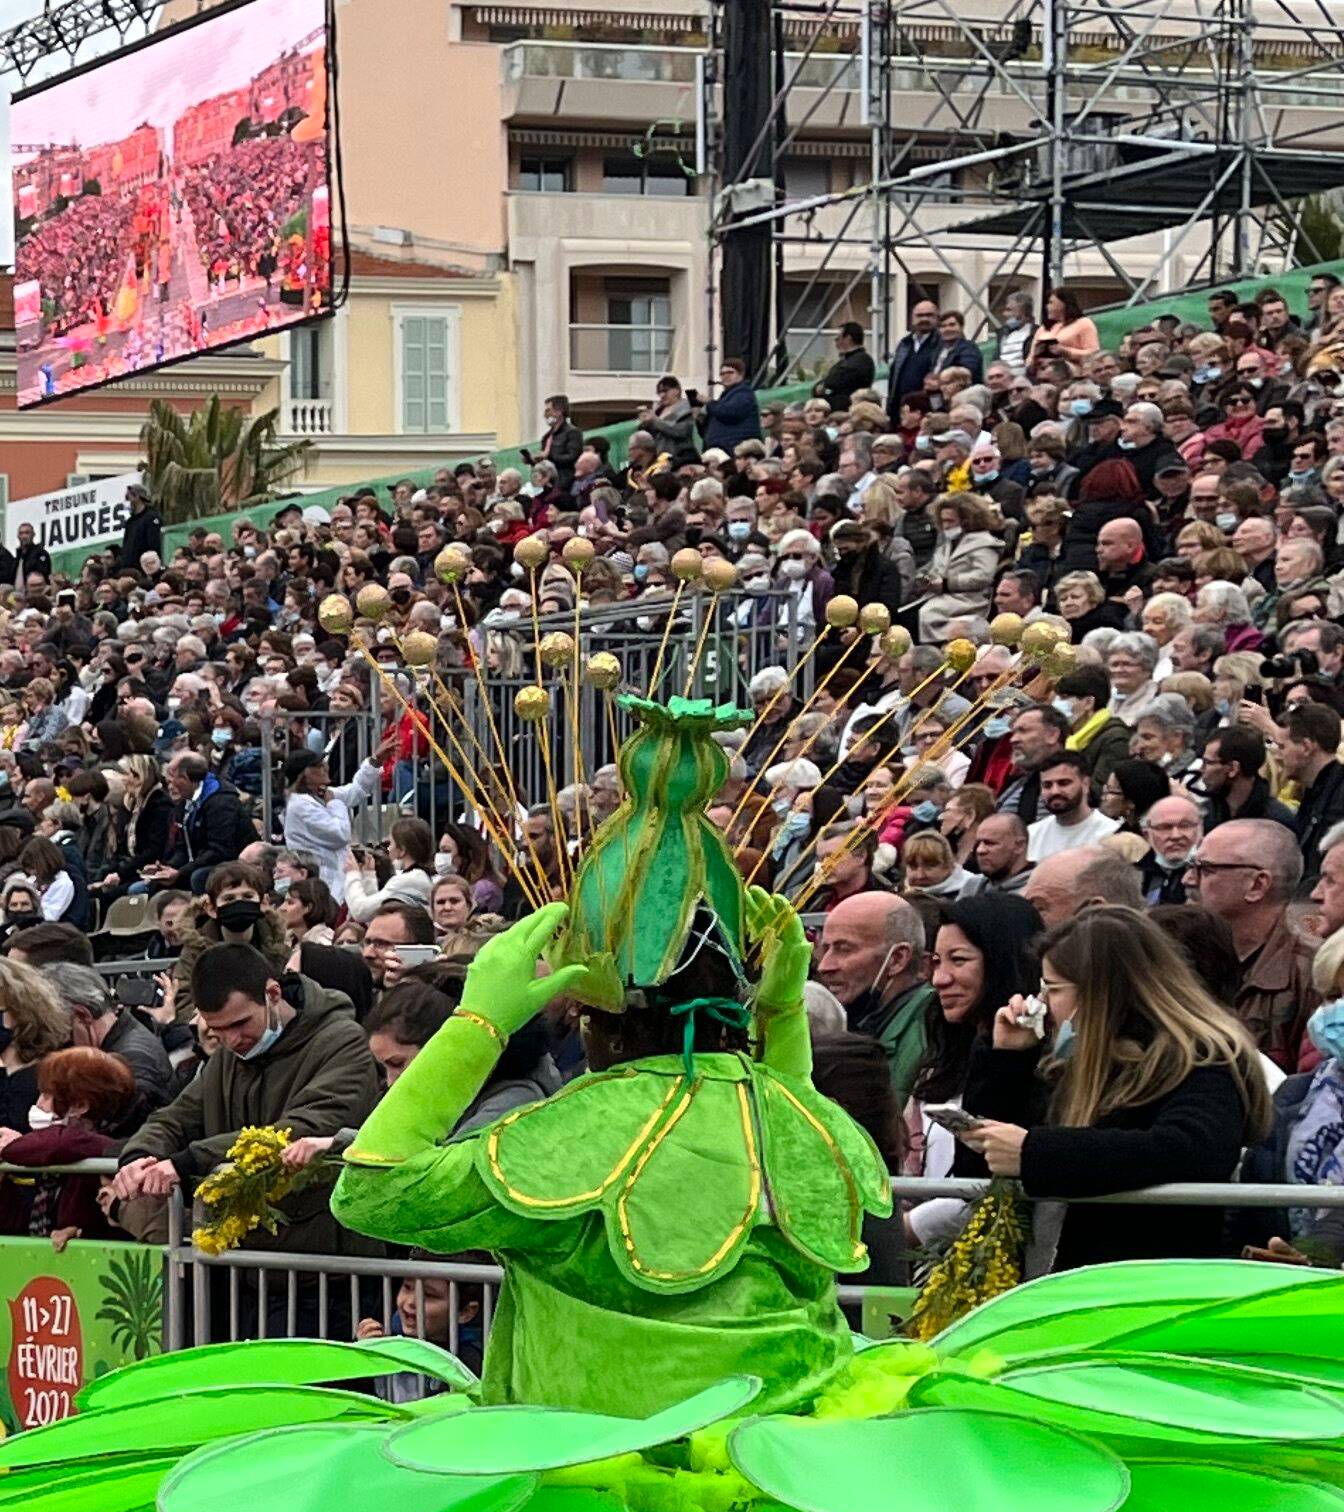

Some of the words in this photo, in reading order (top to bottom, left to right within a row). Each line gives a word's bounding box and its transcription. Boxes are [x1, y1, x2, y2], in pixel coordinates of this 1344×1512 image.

[44, 489, 97, 515] TRIBUNE
[17, 1335, 79, 1387] FÉVRIER
[24, 1387, 71, 1427] 2022
